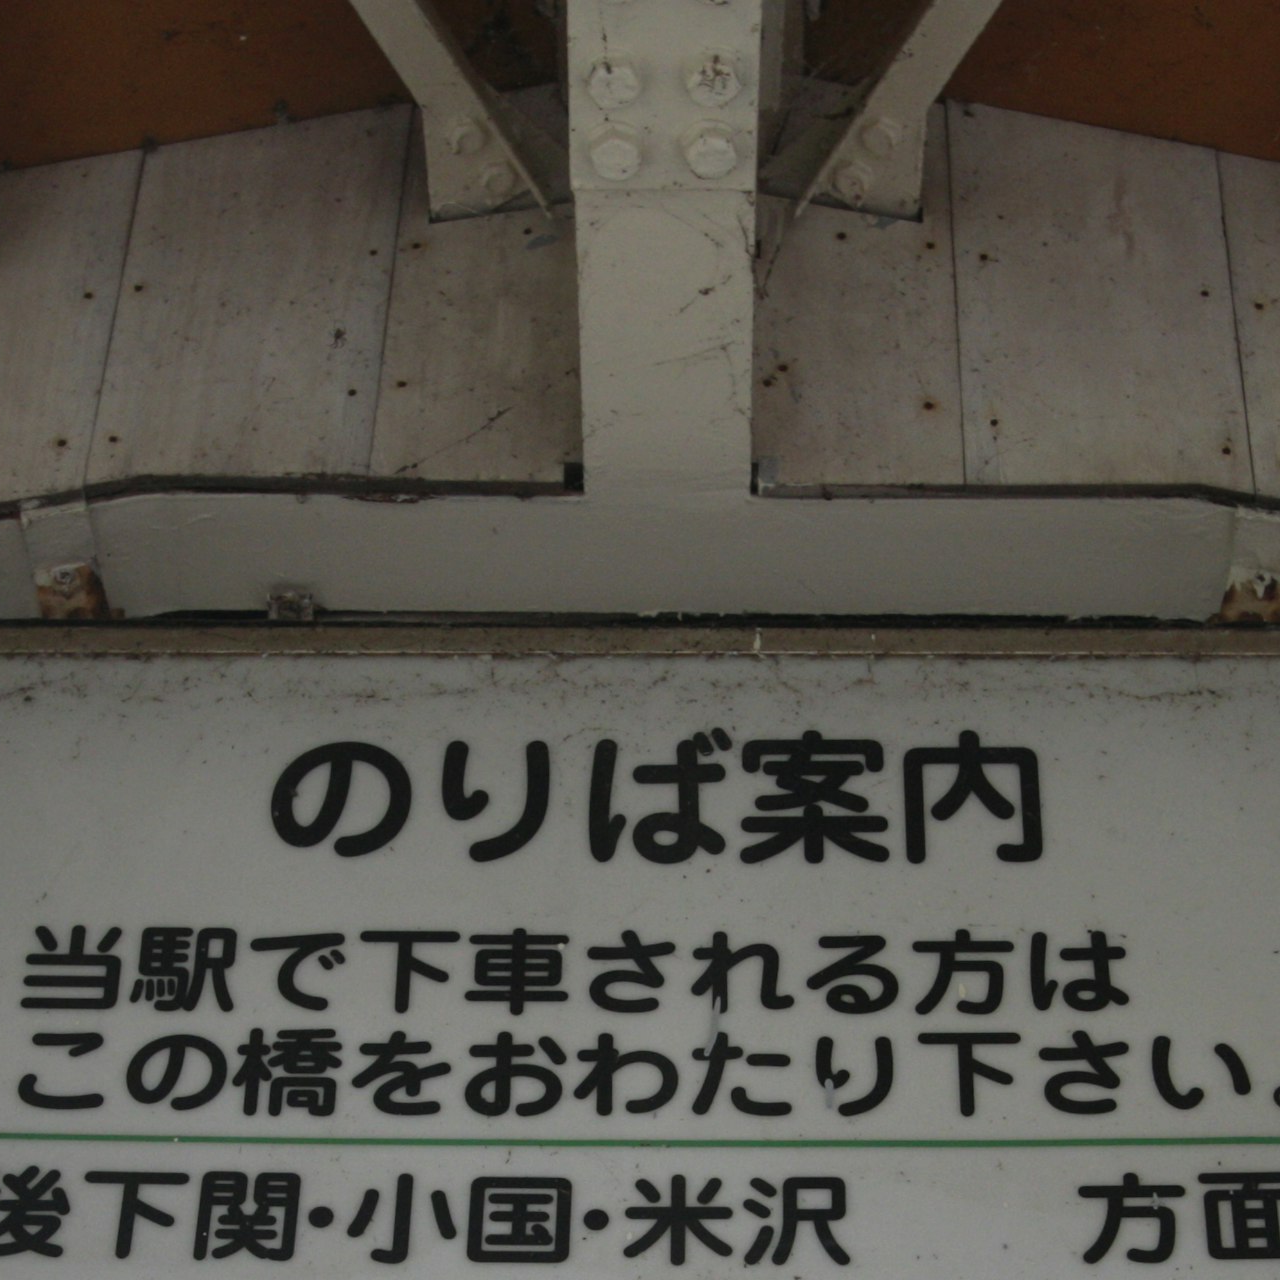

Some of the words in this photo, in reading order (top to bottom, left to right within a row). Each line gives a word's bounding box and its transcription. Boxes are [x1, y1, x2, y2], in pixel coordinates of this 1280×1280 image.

[271, 726, 1044, 865] のりば案内
[19, 924, 1131, 1017] 当駅で下車される方は
